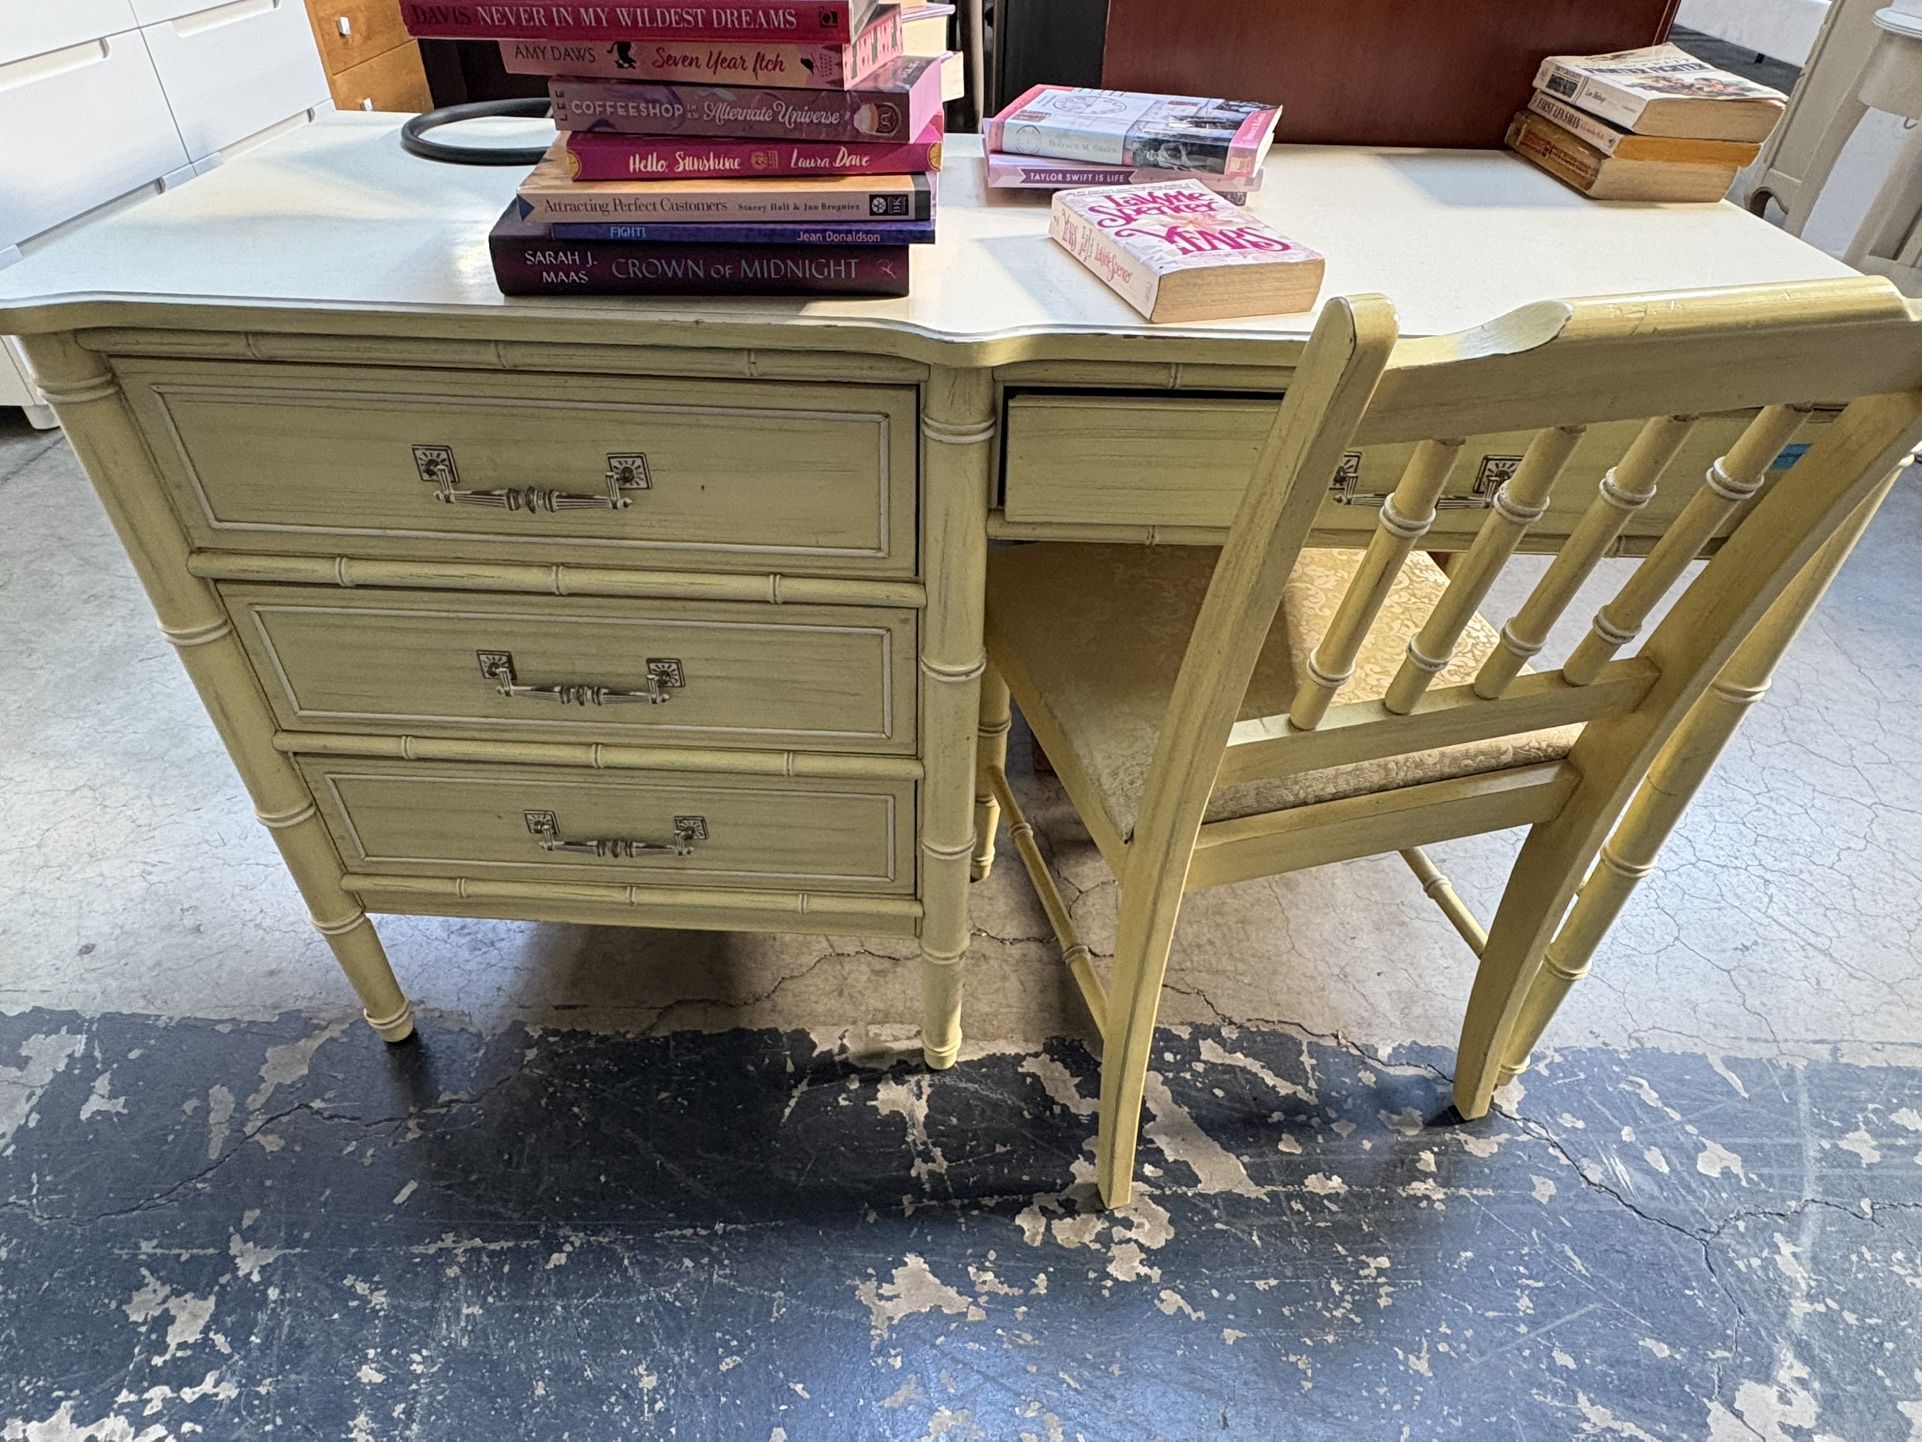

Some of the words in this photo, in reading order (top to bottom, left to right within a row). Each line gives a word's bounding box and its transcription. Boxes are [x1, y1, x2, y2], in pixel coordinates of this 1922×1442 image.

[476, 6, 548, 27] NEVER
[552, 7, 574, 27] IN
[579, 7, 610, 27] MY
[615, 7, 706, 28] WILDEST
[712, 8, 797, 29] DREAMS
[514, 45, 546, 61] AMY
[551, 47, 596, 63] DAWS
[652, 47, 701, 68] Seven
[706, 50, 748, 75] Year
[752, 51, 785, 74] Itch
[555, 90, 568, 121] LEE
[571, 100, 684, 118] COFFEESHOP
[703, 101, 773, 126] Alternate
[773, 100, 841, 128] Universe
[674, 151, 741, 173] Sunshine
[790, 148, 830, 169] Laura
[833, 146, 870, 167] Dave
[1030, 172, 1063, 181] TAYLOR
[1066, 173, 1092, 182] SWIFT
[1095, 173, 1104, 182] IS
[1107, 174, 1124, 182] LIFE
[544, 198, 610, 215] Attracting
[612, 197, 656, 213] Perfect
[660, 198, 728, 213] Customers
[737, 203, 767, 213] Stacey
[770, 202, 790, 211] Hall
[803, 203, 819, 211] Jan
[1088, 198, 1219, 228] Spencer
[610, 226, 647, 238] FIGHT!
[797, 231, 823, 242] Jean
[826, 232, 881, 243] Donaldson
[1114, 225, 1291, 256] YEARS
[525, 251, 580, 265] SARAH
[586, 251, 598, 267] J.
[611, 258, 705, 279] CROWN
[711, 264, 734, 279] OF
[740, 259, 860, 279] MIDNIGHT
[542, 271, 589, 284] MAAS
